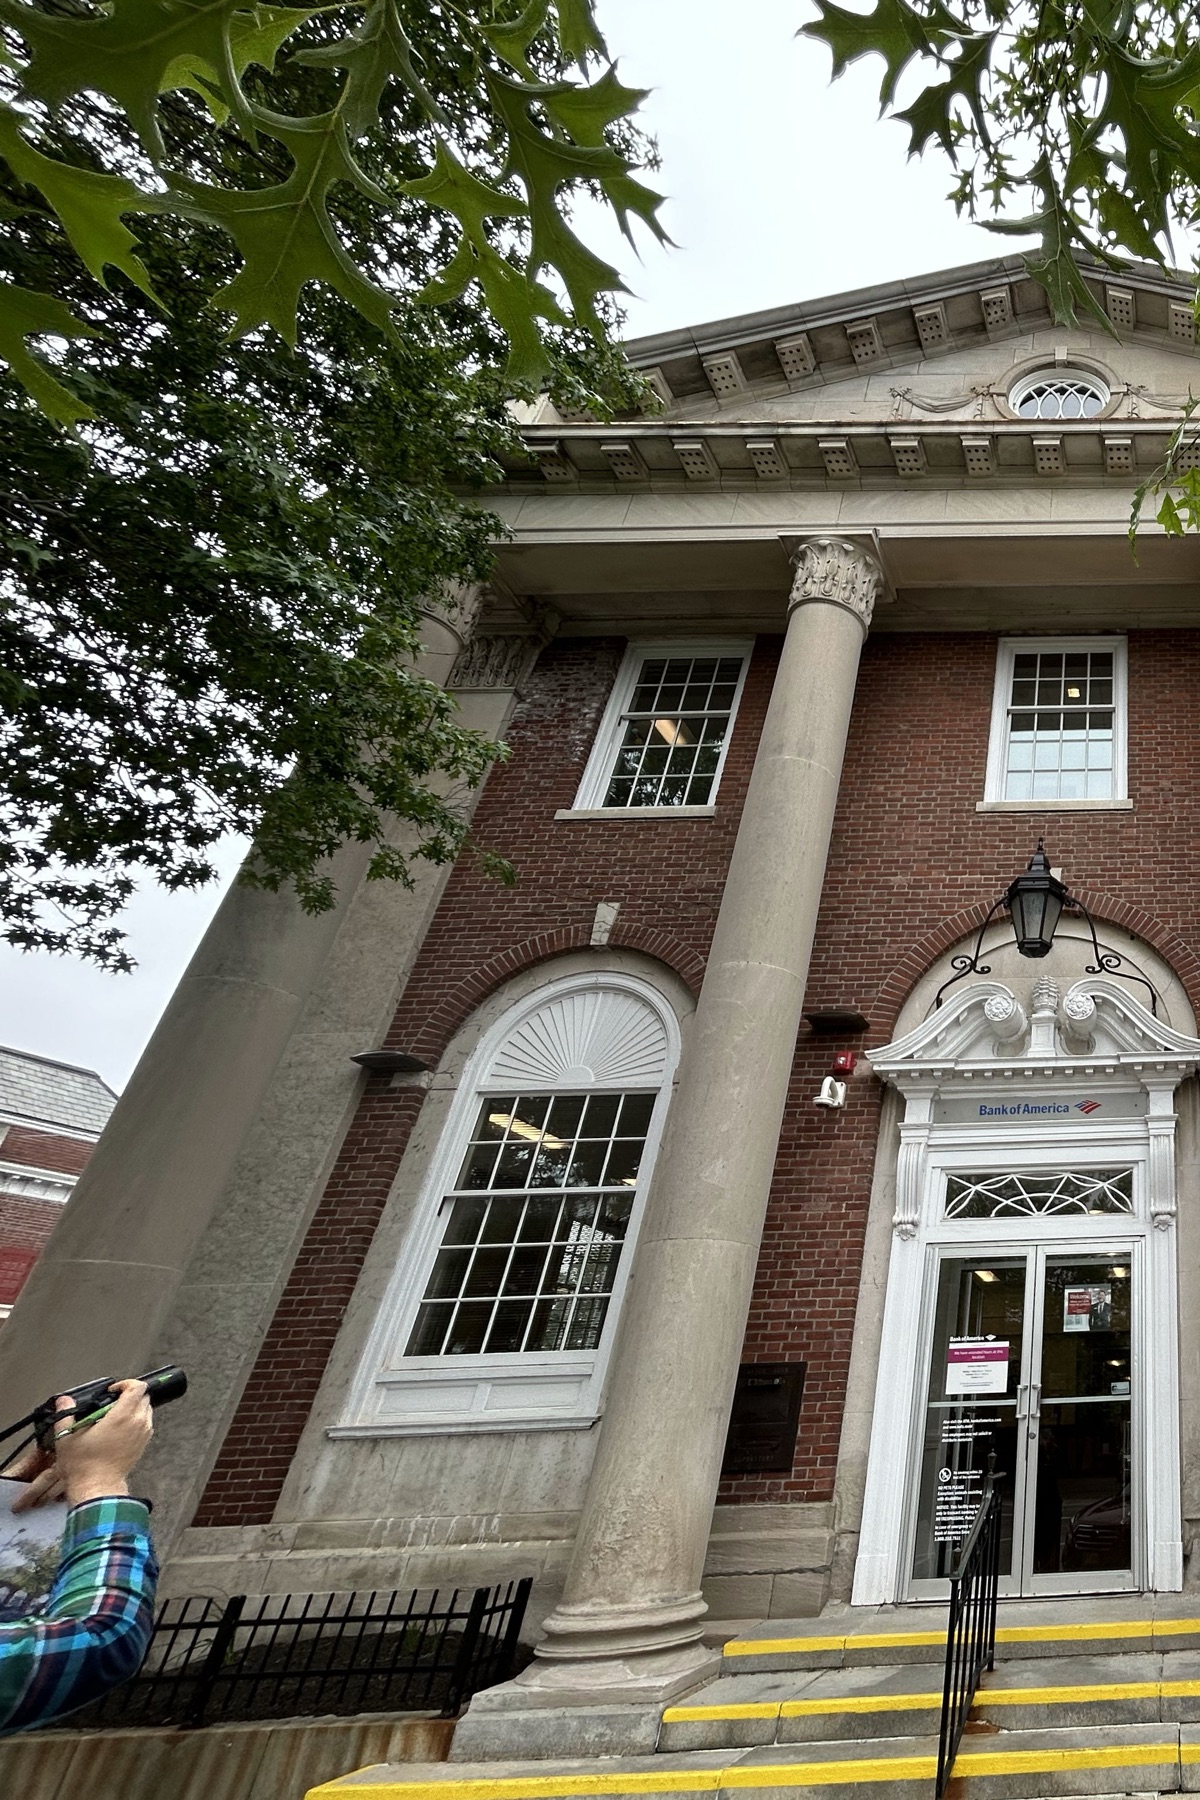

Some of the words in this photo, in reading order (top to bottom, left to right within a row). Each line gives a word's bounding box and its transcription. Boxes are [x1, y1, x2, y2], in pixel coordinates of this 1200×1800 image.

[979, 1104, 1008, 1116] Bank
[1010, 1104, 1022, 1115] of
[1022, 1102, 1069, 1114] America
